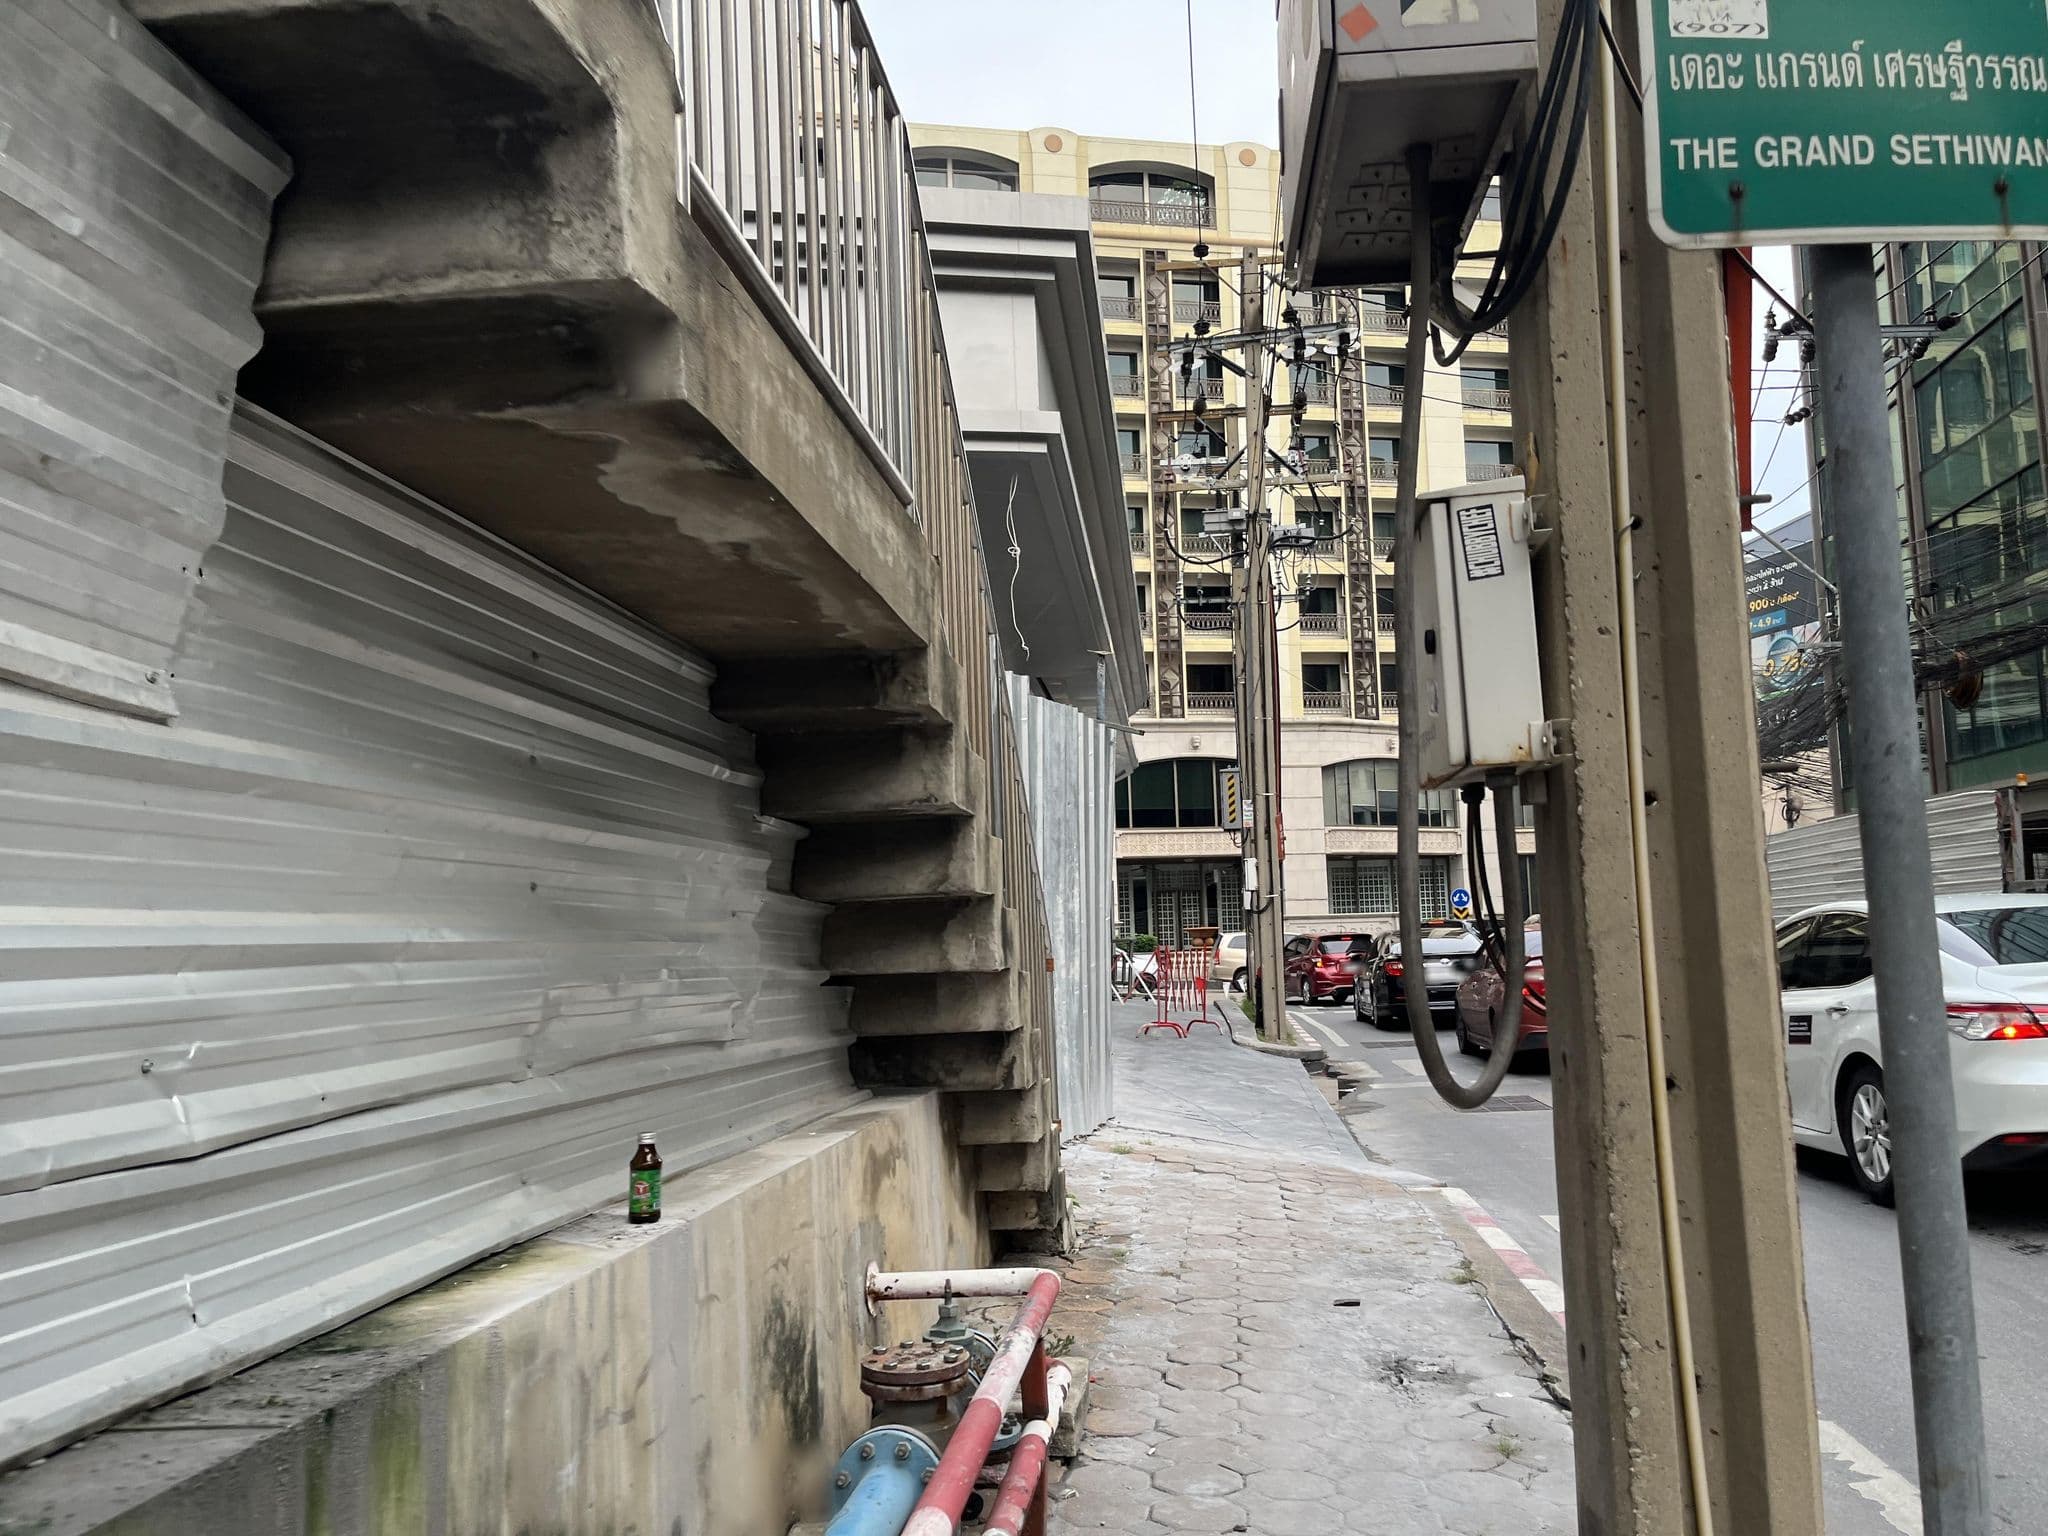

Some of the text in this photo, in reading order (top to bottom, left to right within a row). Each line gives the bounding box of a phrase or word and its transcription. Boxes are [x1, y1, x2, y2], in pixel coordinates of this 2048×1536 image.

[1669, 39, 2048, 101] เดอะ แกรนด์ เศรษฐีวรรณ
[1670, 133, 2048, 170] THE GRAND SETHIWAN
[1458, 507, 1502, 578] #CHUBBYCHEF
